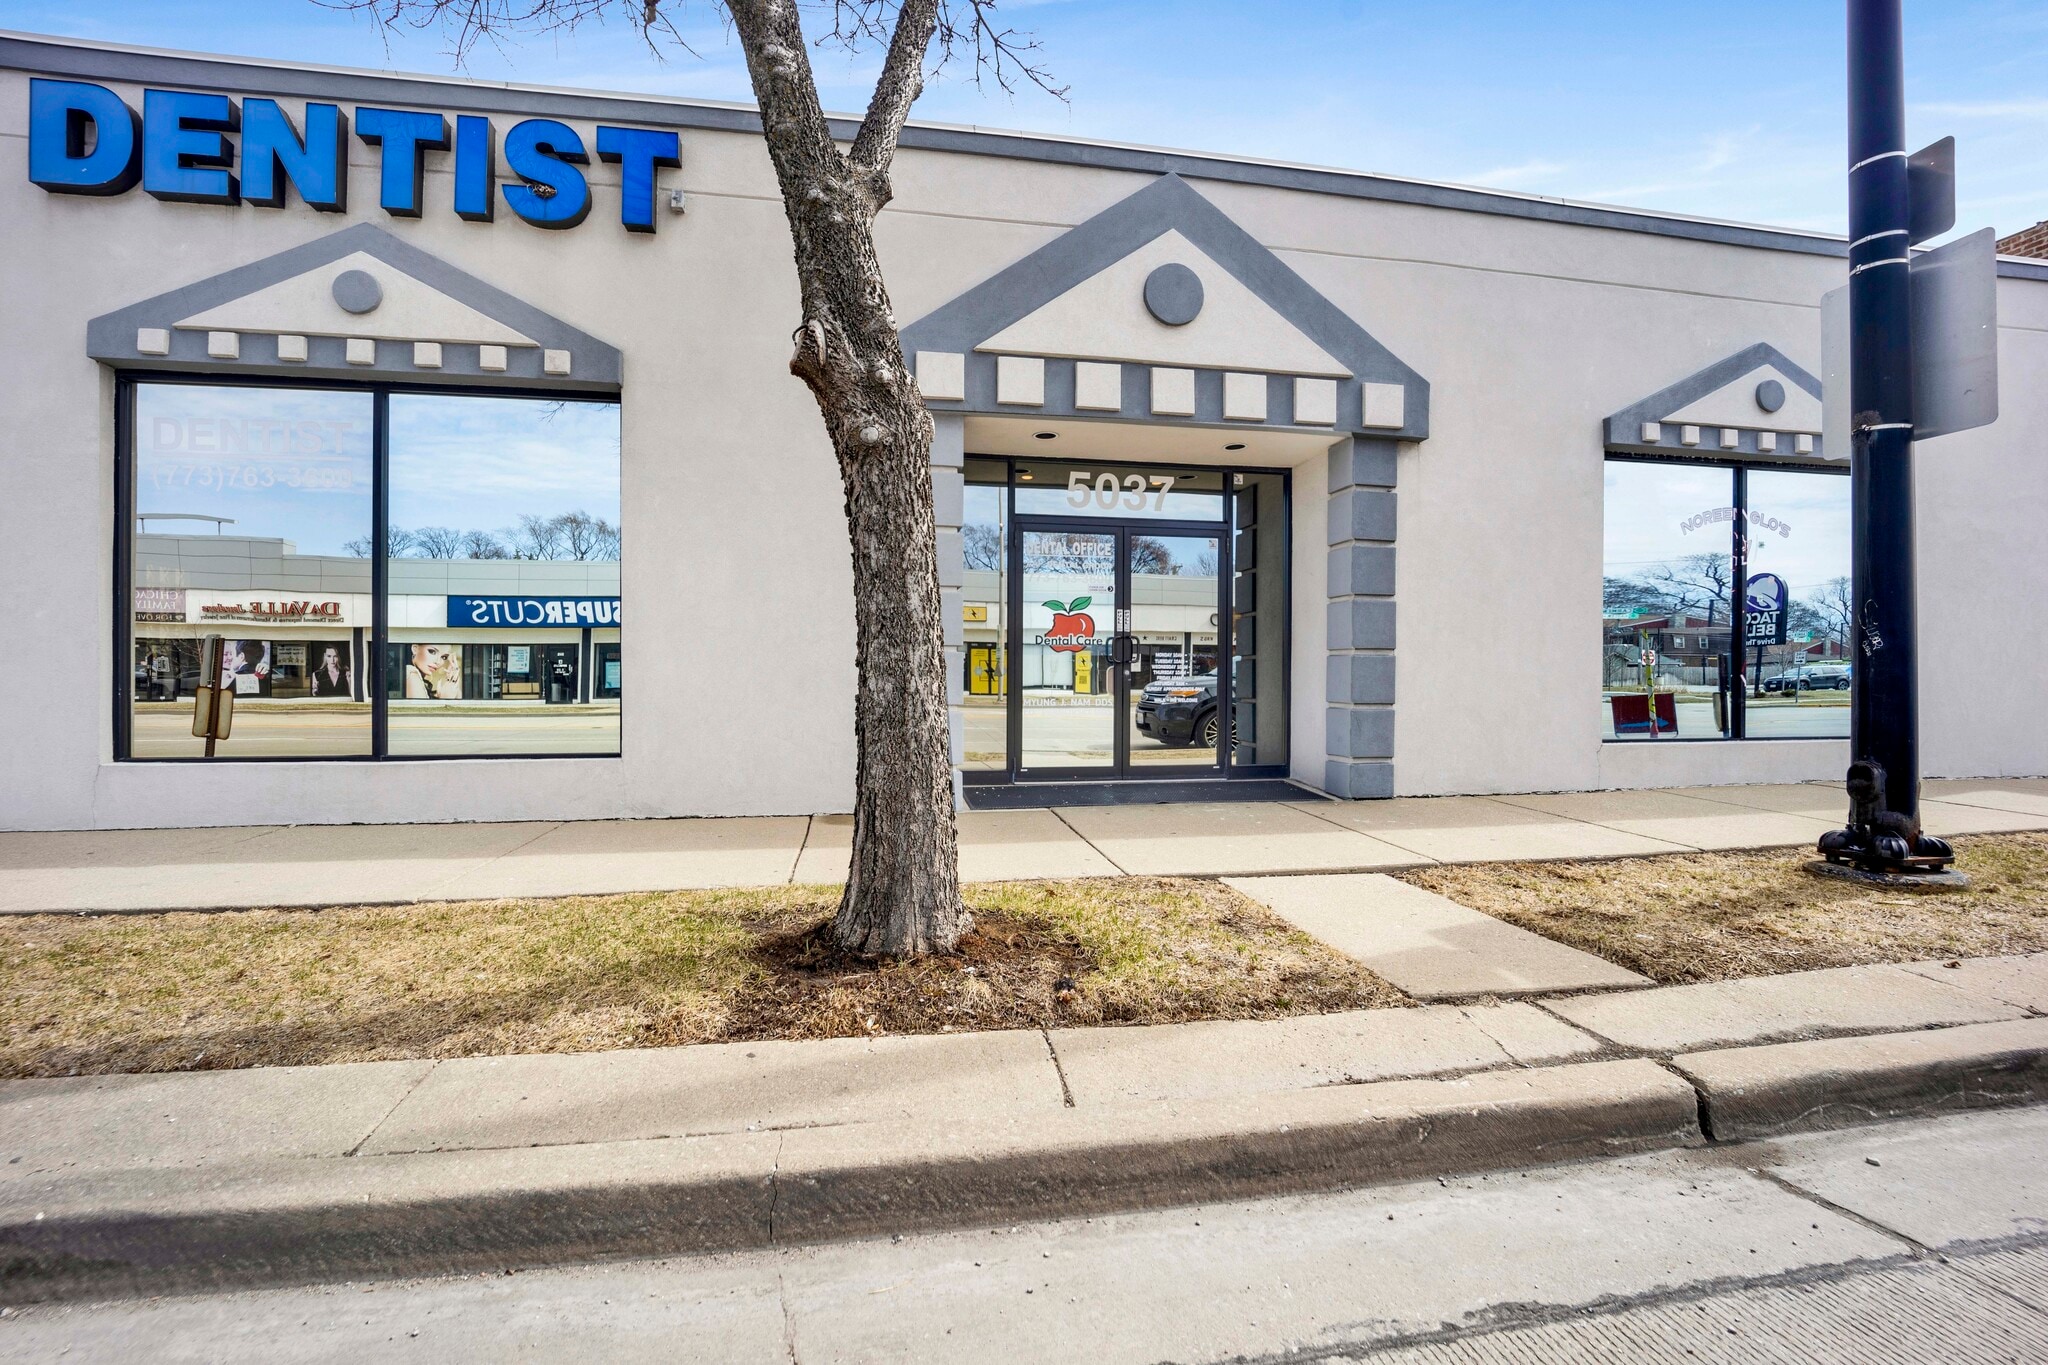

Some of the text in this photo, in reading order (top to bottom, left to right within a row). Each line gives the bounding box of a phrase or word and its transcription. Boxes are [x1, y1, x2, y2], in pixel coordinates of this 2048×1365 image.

[29, 77, 682, 234] DENTIST
[153, 416, 353, 455] DENTIST
[1066, 471, 1175, 512] 5037
[1679, 507, 1738, 536] NOREE
[1027, 540, 1112, 557] DENTAL OFFICE
[1035, 634, 1103, 647] Dental Care
[1023, 697, 1056, 706] MYUNG
[1070, 698, 1091, 706] NAM
[1095, 698, 1113, 706] DDS
